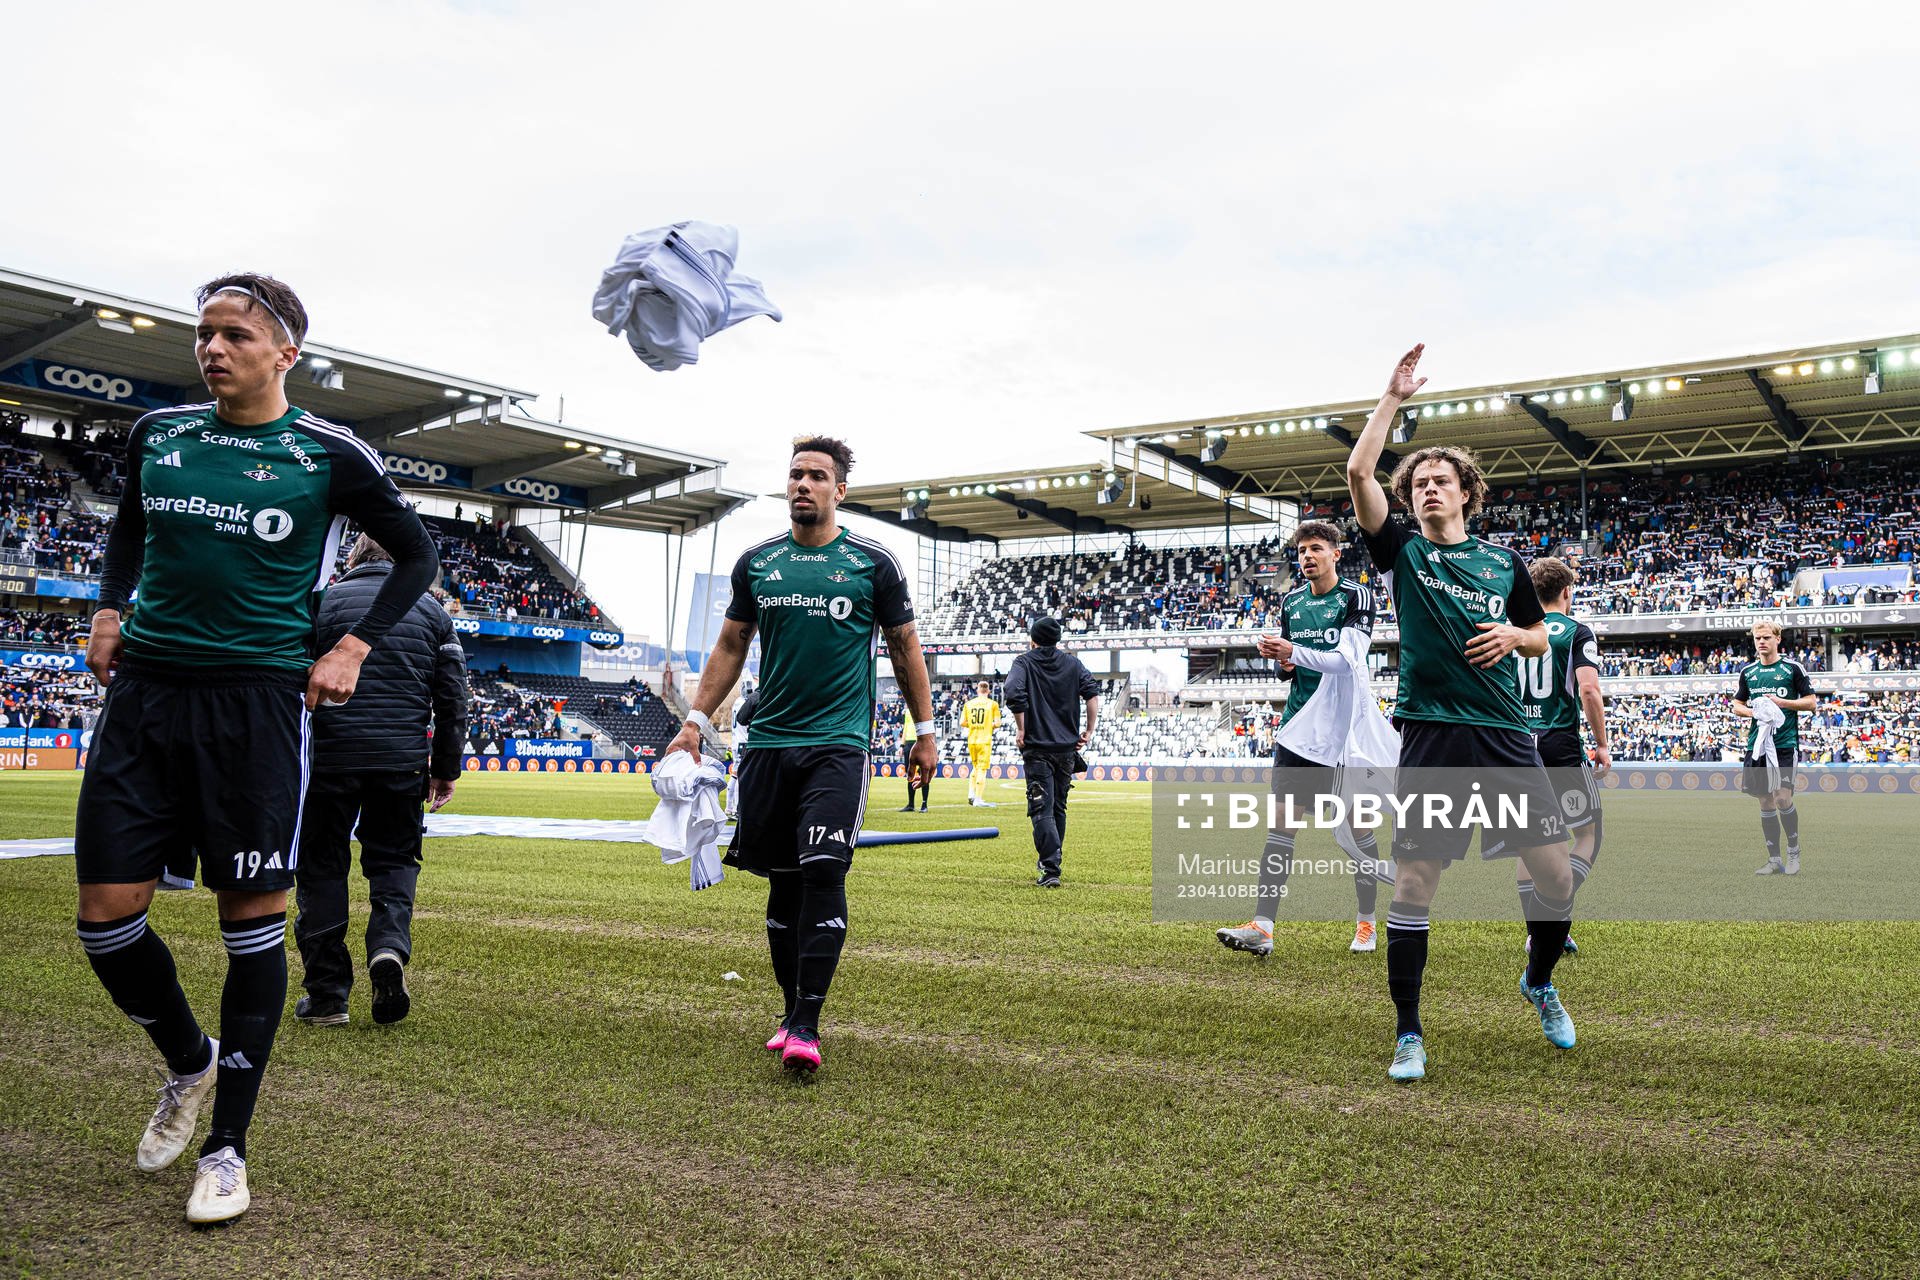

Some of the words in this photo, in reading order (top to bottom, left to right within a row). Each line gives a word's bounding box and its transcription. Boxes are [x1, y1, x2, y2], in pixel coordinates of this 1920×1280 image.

[44, 365, 133, 400] coop
[167, 419, 205, 438] OBOS
[200, 431, 264, 450] Scandic
[289, 445, 318, 472] OBOS
[384, 455, 447, 483] coop
[505, 479, 560, 502] coop
[142, 493, 251, 522] SpareBank
[215, 521, 248, 535] SMN
[766, 546, 789, 562] OBOS
[790, 553, 829, 562] Scandic
[846, 553, 866, 569] OBOS
[1443, 551, 1471, 560] andic
[1487, 552, 1510, 568] OBOS
[757, 593, 828, 609] SpareBank
[1466, 603, 1486, 613] SMN
[807, 609, 827, 617] SMN
[1796, 611, 1862, 626] STADION
[452, 619, 480, 633] oop
[532, 626, 564, 640] coop
[590, 631, 620, 644] coop
[971, 708, 985, 725] 30
[1541, 815, 1560, 837] 32
[808, 826, 827, 845] 17
[233, 851, 262, 879] 19
